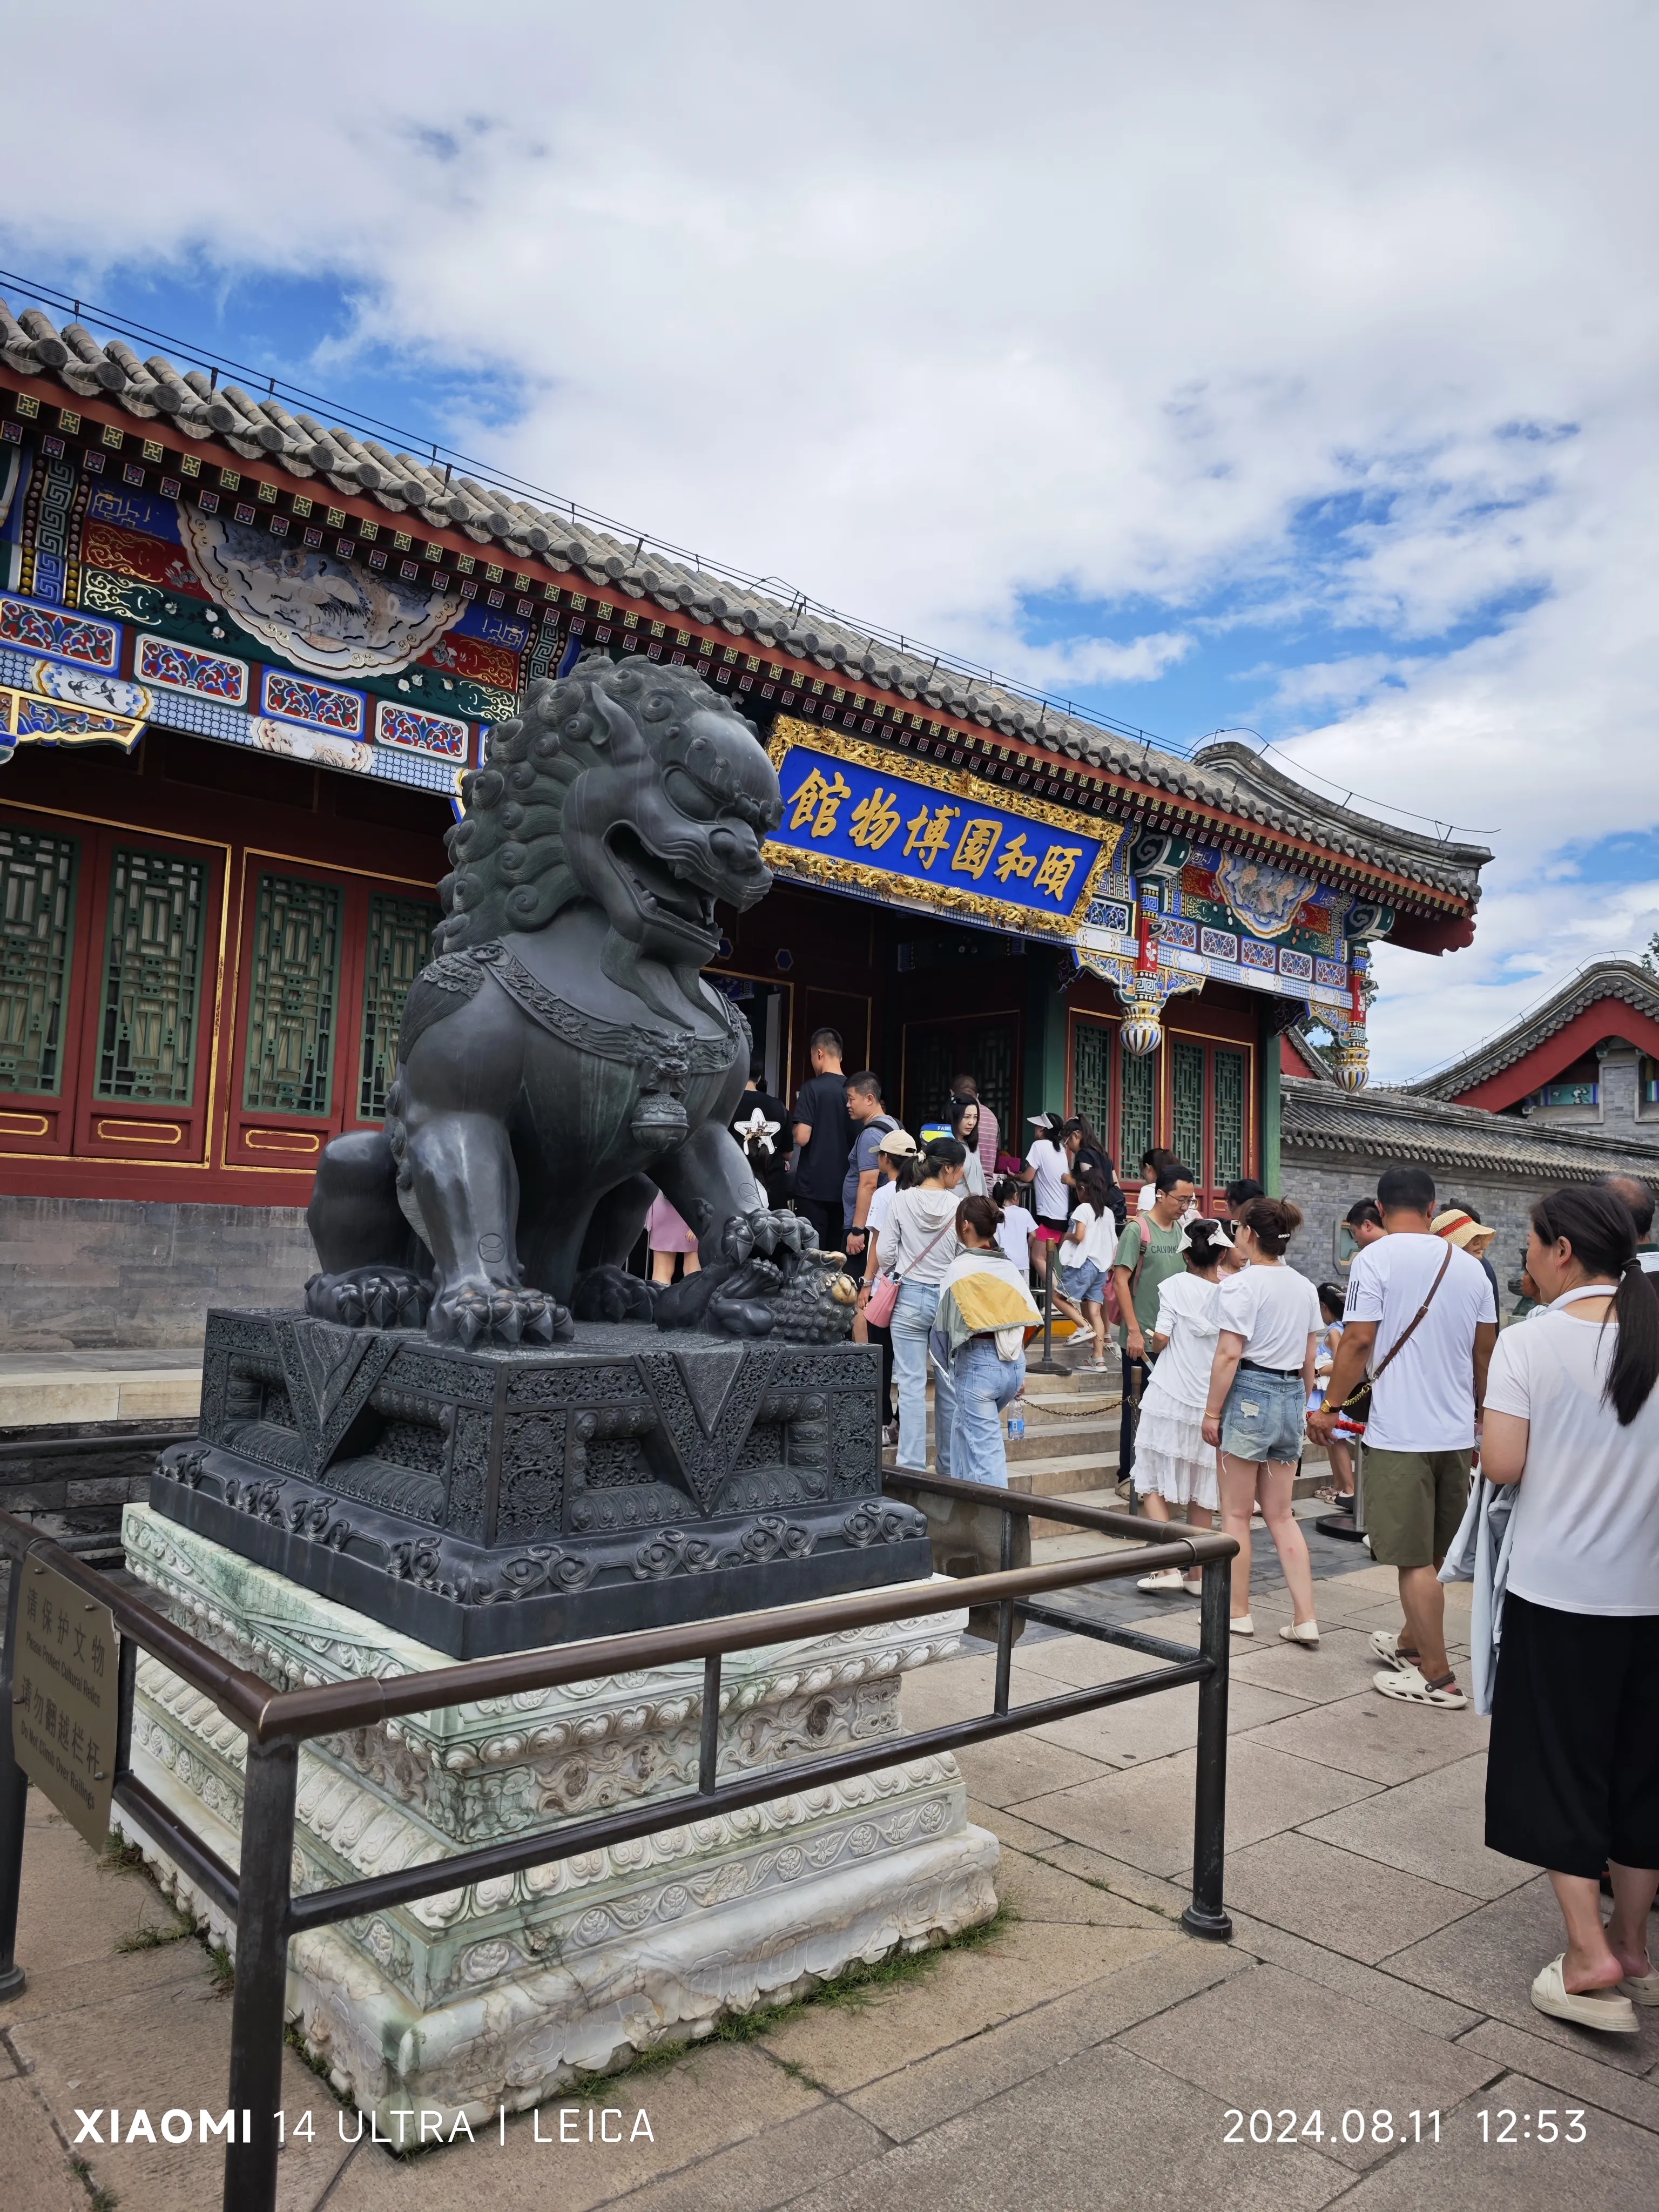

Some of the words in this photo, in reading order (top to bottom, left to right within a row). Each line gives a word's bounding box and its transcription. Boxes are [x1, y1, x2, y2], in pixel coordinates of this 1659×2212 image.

[26, 1630, 42, 1657] Please
[42, 1644, 60, 1674] Protect
[61, 1661, 82, 1692] Cultural
[83, 1679, 101, 1708] Relics
[27, 1586, 105, 1678] 请保护文物
[21, 1719, 28, 1738] Do
[29, 1731, 38, 1748] Not
[39, 1738, 55, 1768] Climb
[56, 1756, 69, 1782] Over
[70, 1771, 95, 1810] Railings
[22, 1675, 99, 1774] 请勿翻越栏杆
